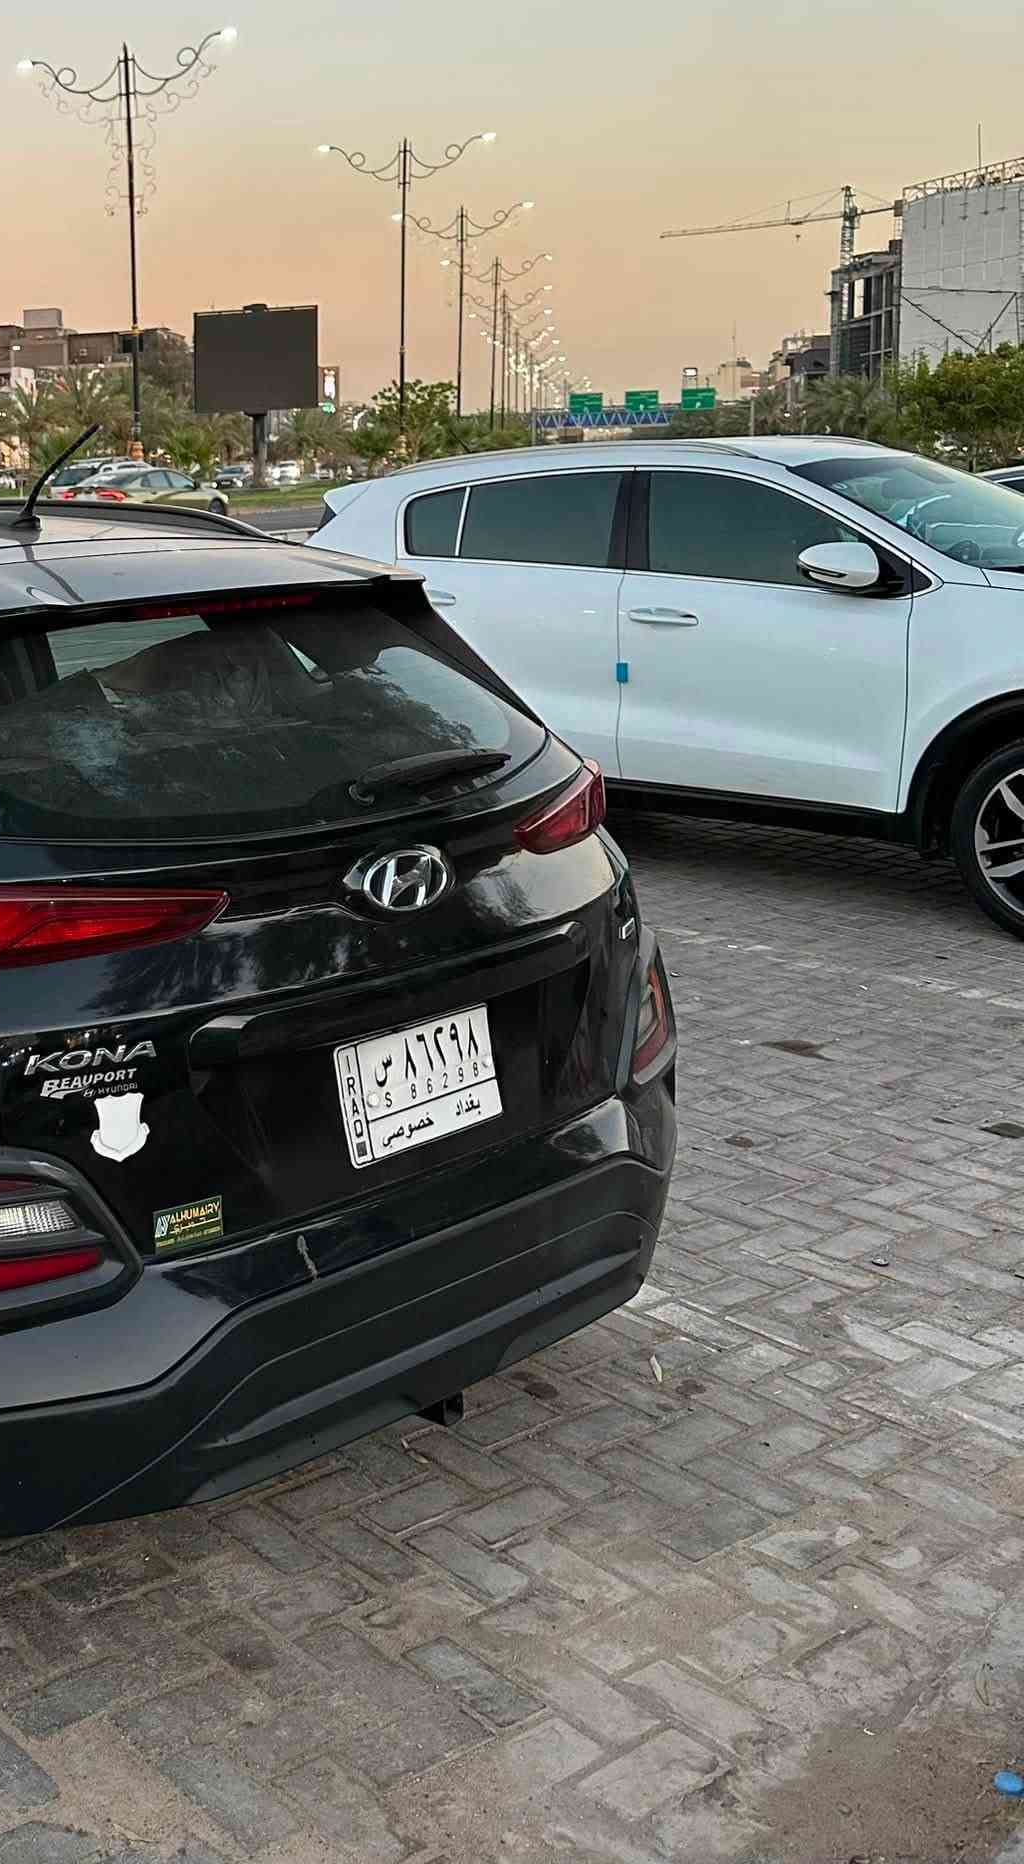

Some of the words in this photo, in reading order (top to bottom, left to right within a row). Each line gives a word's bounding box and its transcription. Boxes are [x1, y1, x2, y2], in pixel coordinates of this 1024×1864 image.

[24, 1040, 157, 1076] KONA
[375, 1053, 393, 1087] س
[403, 1016, 479, 1081] ٨٦٢٩٨
[39, 1068, 137, 1098] BEAUPORT
[384, 1092, 393, 1108] S
[455, 1093, 481, 1116] بغداد
[382, 1112, 435, 1149] خصوصي
